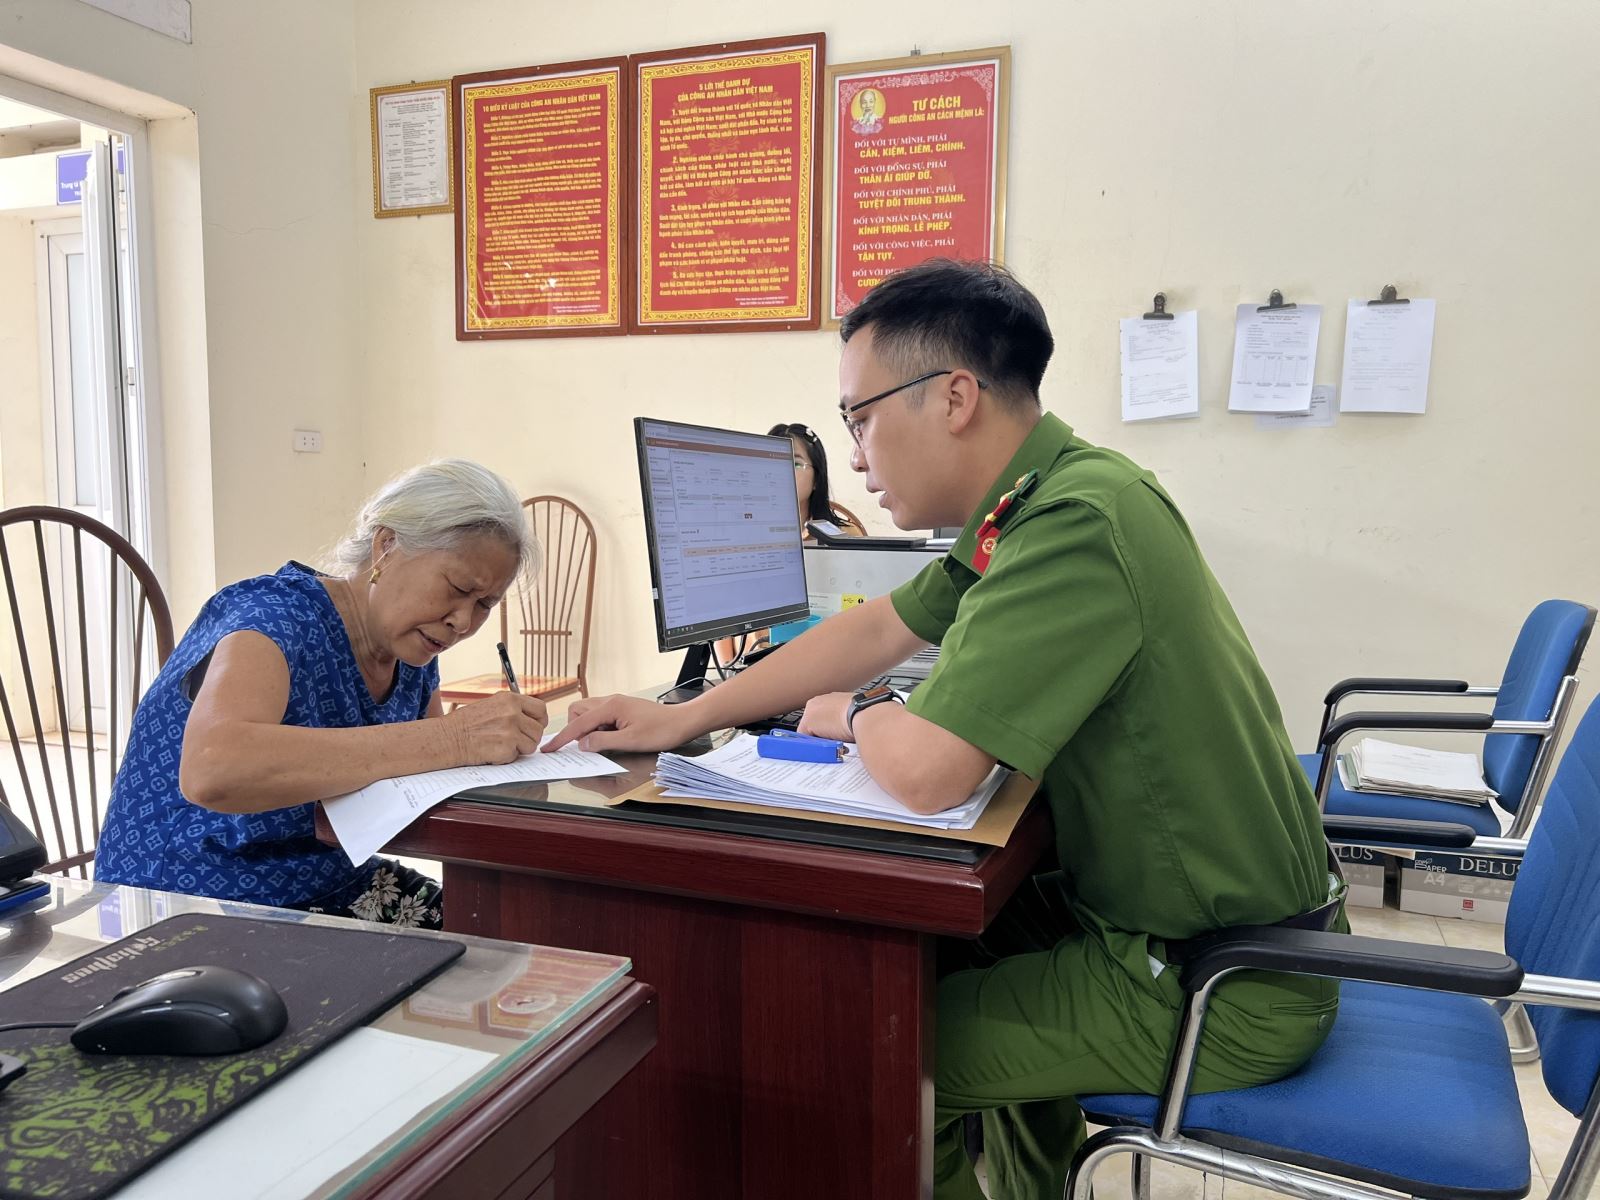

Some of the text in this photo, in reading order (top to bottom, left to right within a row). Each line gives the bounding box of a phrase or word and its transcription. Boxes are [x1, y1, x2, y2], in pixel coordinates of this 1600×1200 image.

[913, 95, 960, 111] TƯ CÁCH
[854, 140, 870, 148] ĐỐI
[871, 139, 886, 147] VỚI
[900, 136, 925, 144] MÌNH,
[927, 134, 947, 143] PHẢI
[882, 146, 907, 157] KIỆM,
[909, 143, 934, 155] LIÊM,
[936, 142, 965, 152] CHÍNH.
[854, 166, 869, 174] ĐỐI
[871, 165, 886, 173] VỚI
[887, 163, 911, 172] ĐỒNG
[926, 160, 947, 169] PHẢI
[860, 174, 882, 185] THÂN
[884, 172, 893, 183] ÁI
[895, 171, 916, 182] GIÚP
[854, 191, 868, 199] ĐỐI
[871, 189, 885, 198] VỚI
[886, 188, 914, 197] CHÍNH
[936, 184, 956, 194] PHẢI
[859, 194, 965, 210] TUYỆT ĐỐI TRUNG THÀNH.
[853, 211, 952, 225] ĐỐI VỚI NHÂN DÂN, PHẢI
[858, 225, 880, 236] KÍNH
[881, 223, 912, 235] TRỌNG,
[927, 220, 952, 230] PHÉP.
[853, 238, 955, 251] ĐỐI VỚI CÔNG VIỆC, PHẢI
[858, 252, 895, 262] TẬN TỤY.
[1338, 846, 1373, 861] LUS
[1458, 857, 1521, 876] DELU
[1424, 873, 1445, 886] A4
